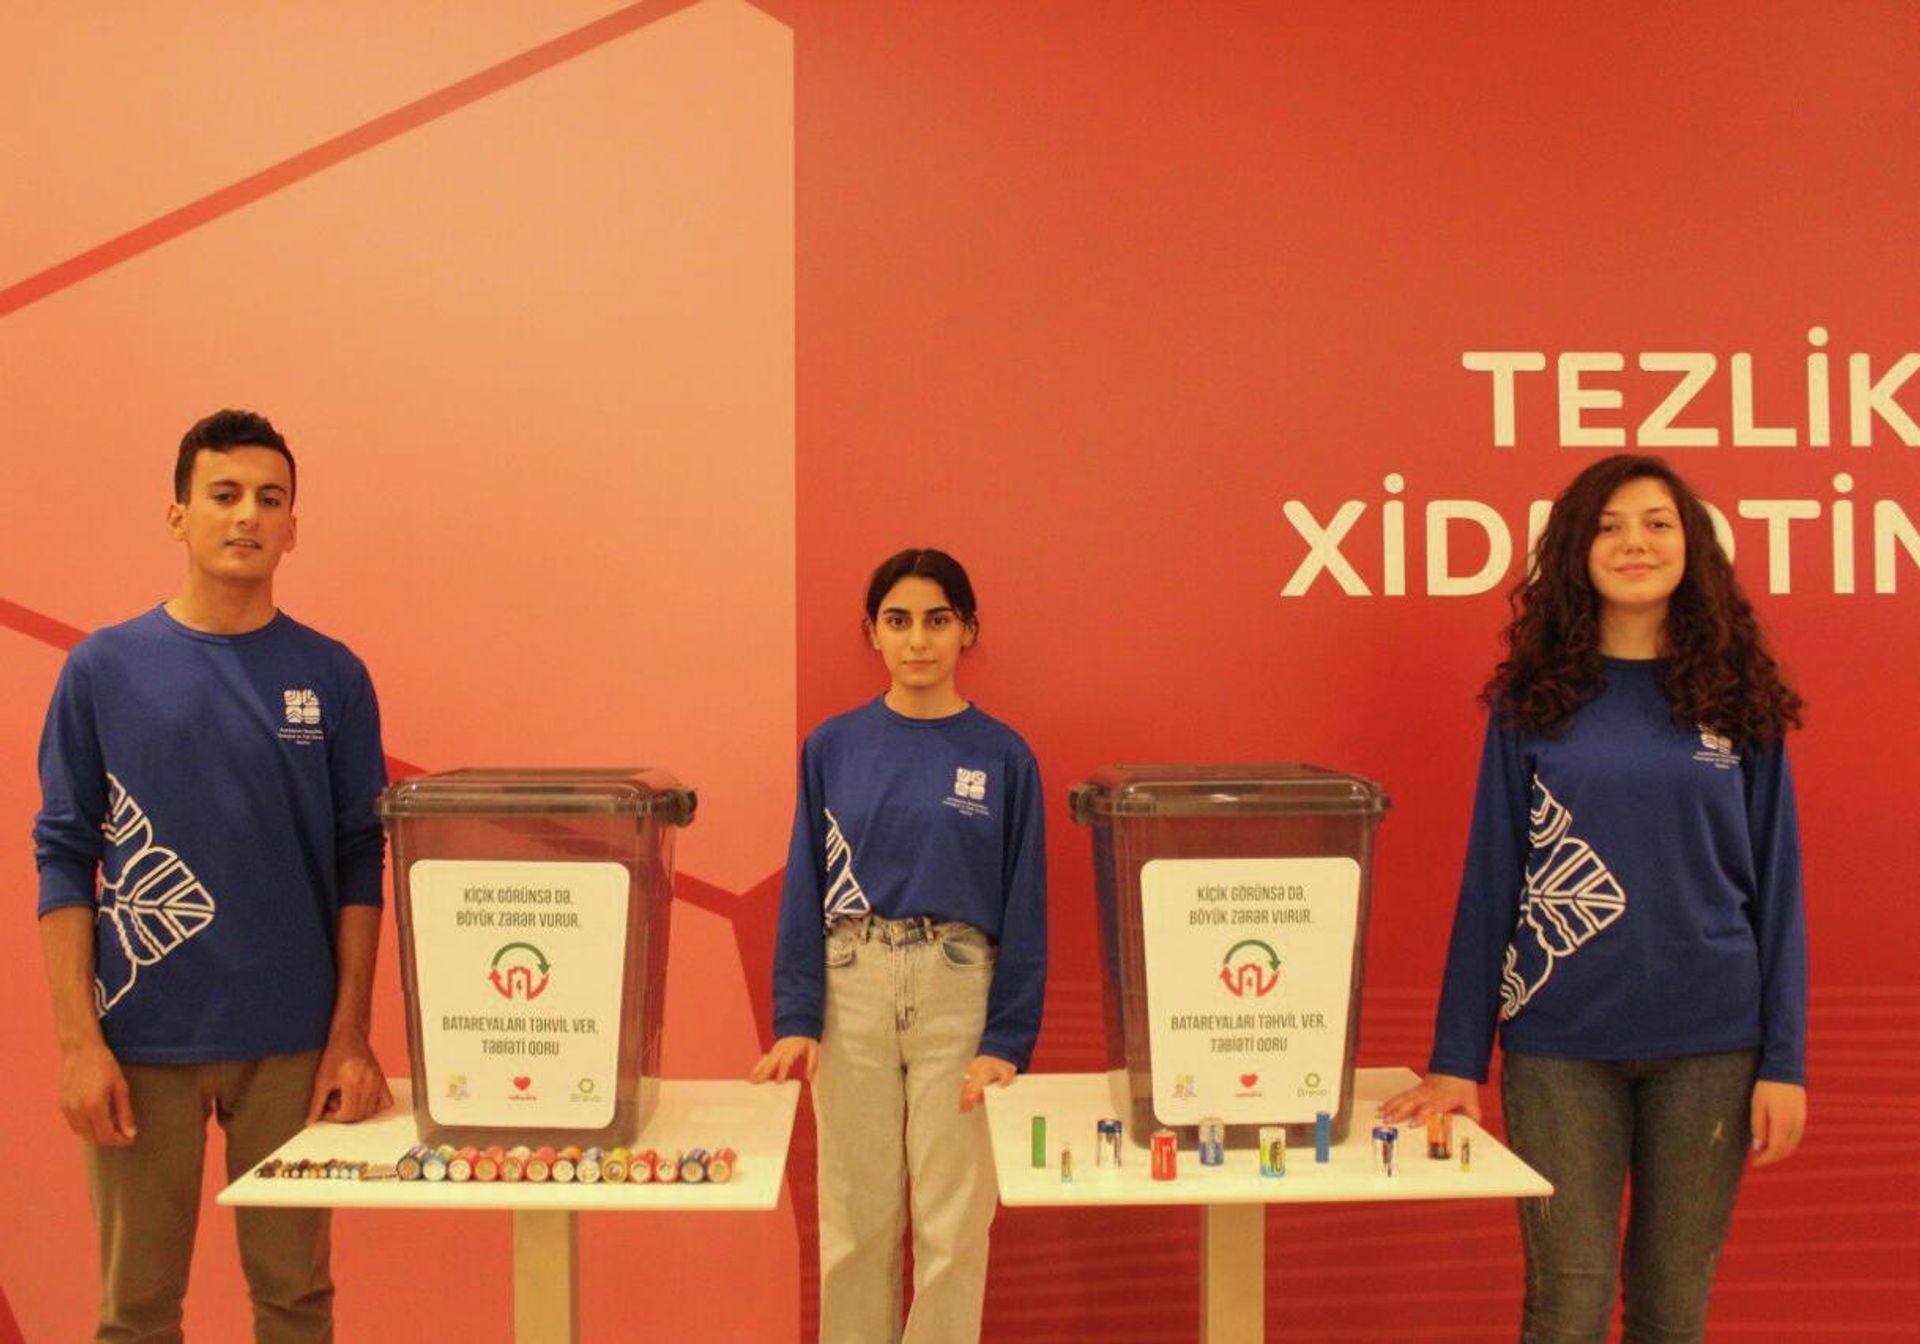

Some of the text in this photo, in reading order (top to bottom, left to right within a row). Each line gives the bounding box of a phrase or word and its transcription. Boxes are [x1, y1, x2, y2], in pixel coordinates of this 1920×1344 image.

[1461, 326, 1920, 448] TEZLİK
[1280, 473, 1920, 598] XİDTİN
[464, 886, 494, 905] KİÇİK
[498, 886, 552, 904] GÖRÜNSƏ
[1198, 884, 1228, 903] KİÇİK
[1231, 884, 1285, 902] GÖRÜNSƏ
[456, 909, 495, 927] BÖYÜK
[498, 910, 536, 927] ZƏRƏR
[1190, 907, 1228, 925] BÖYÜK
[1231, 908, 1269, 925] ZƏRƏR
[442, 1015, 527, 1033] BATAREYALARI
[529, 1015, 569, 1033] TƏHVİL
[1171, 1014, 1255, 1031] BATAREYALARI
[1258, 1013, 1298, 1030] TƏHVİL
[481, 1037, 560, 1056] TƏBİƏTİ QORU
[1210, 1036, 1288, 1053] TƏBİƏTİ QORU
